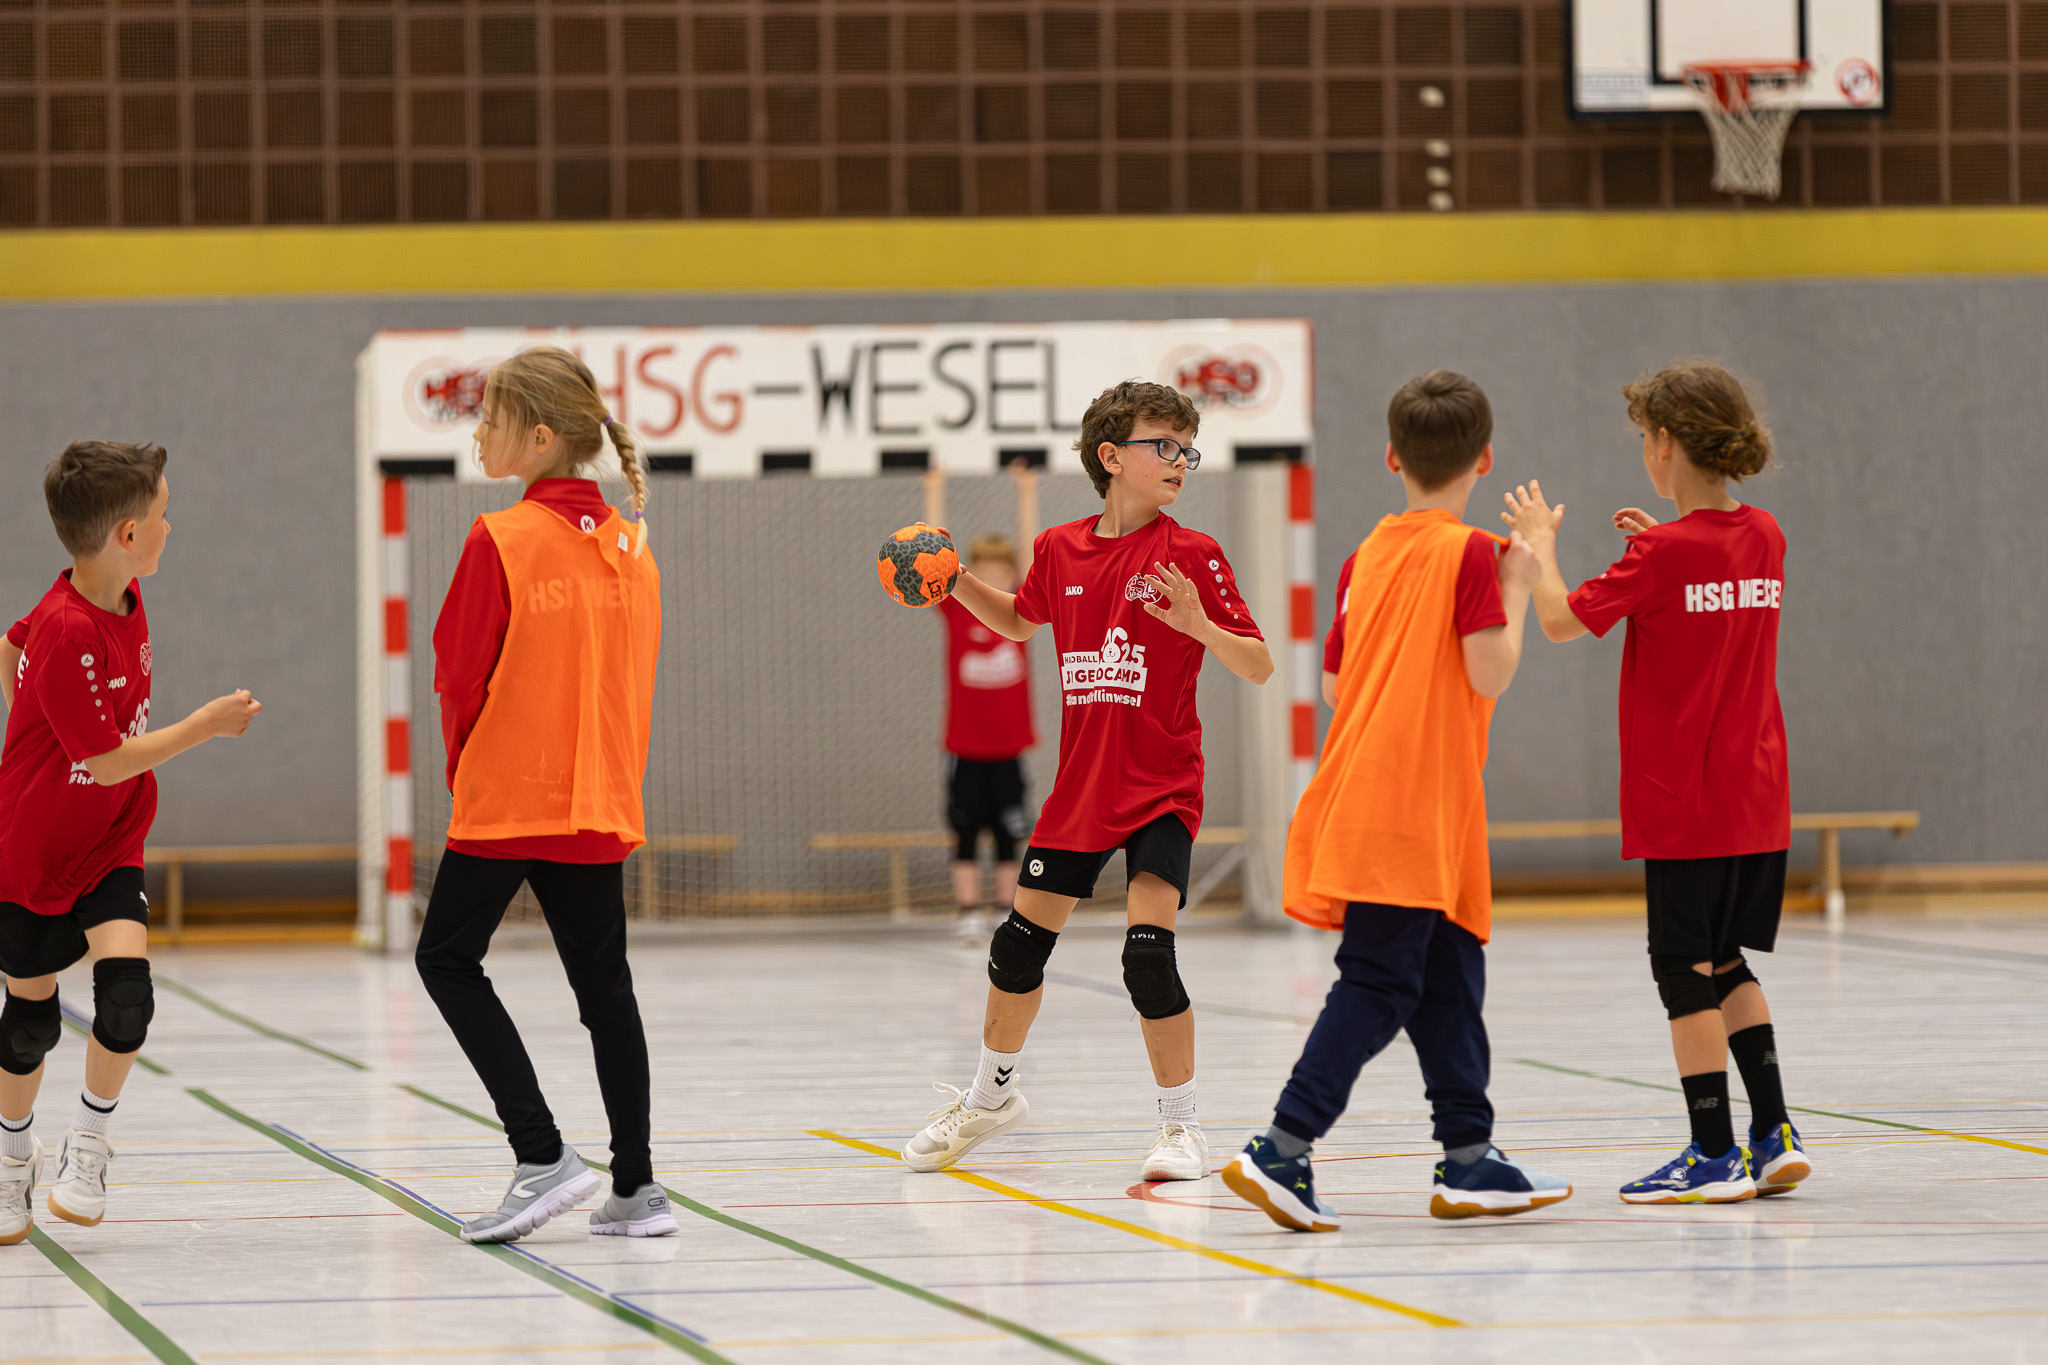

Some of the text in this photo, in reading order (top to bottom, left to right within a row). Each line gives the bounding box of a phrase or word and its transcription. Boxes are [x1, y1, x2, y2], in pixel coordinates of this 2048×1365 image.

[1065, 585, 1083, 596] JAKO
[1685, 578, 1782, 612] HSG WESE
[107, 676, 126, 690] AKO
